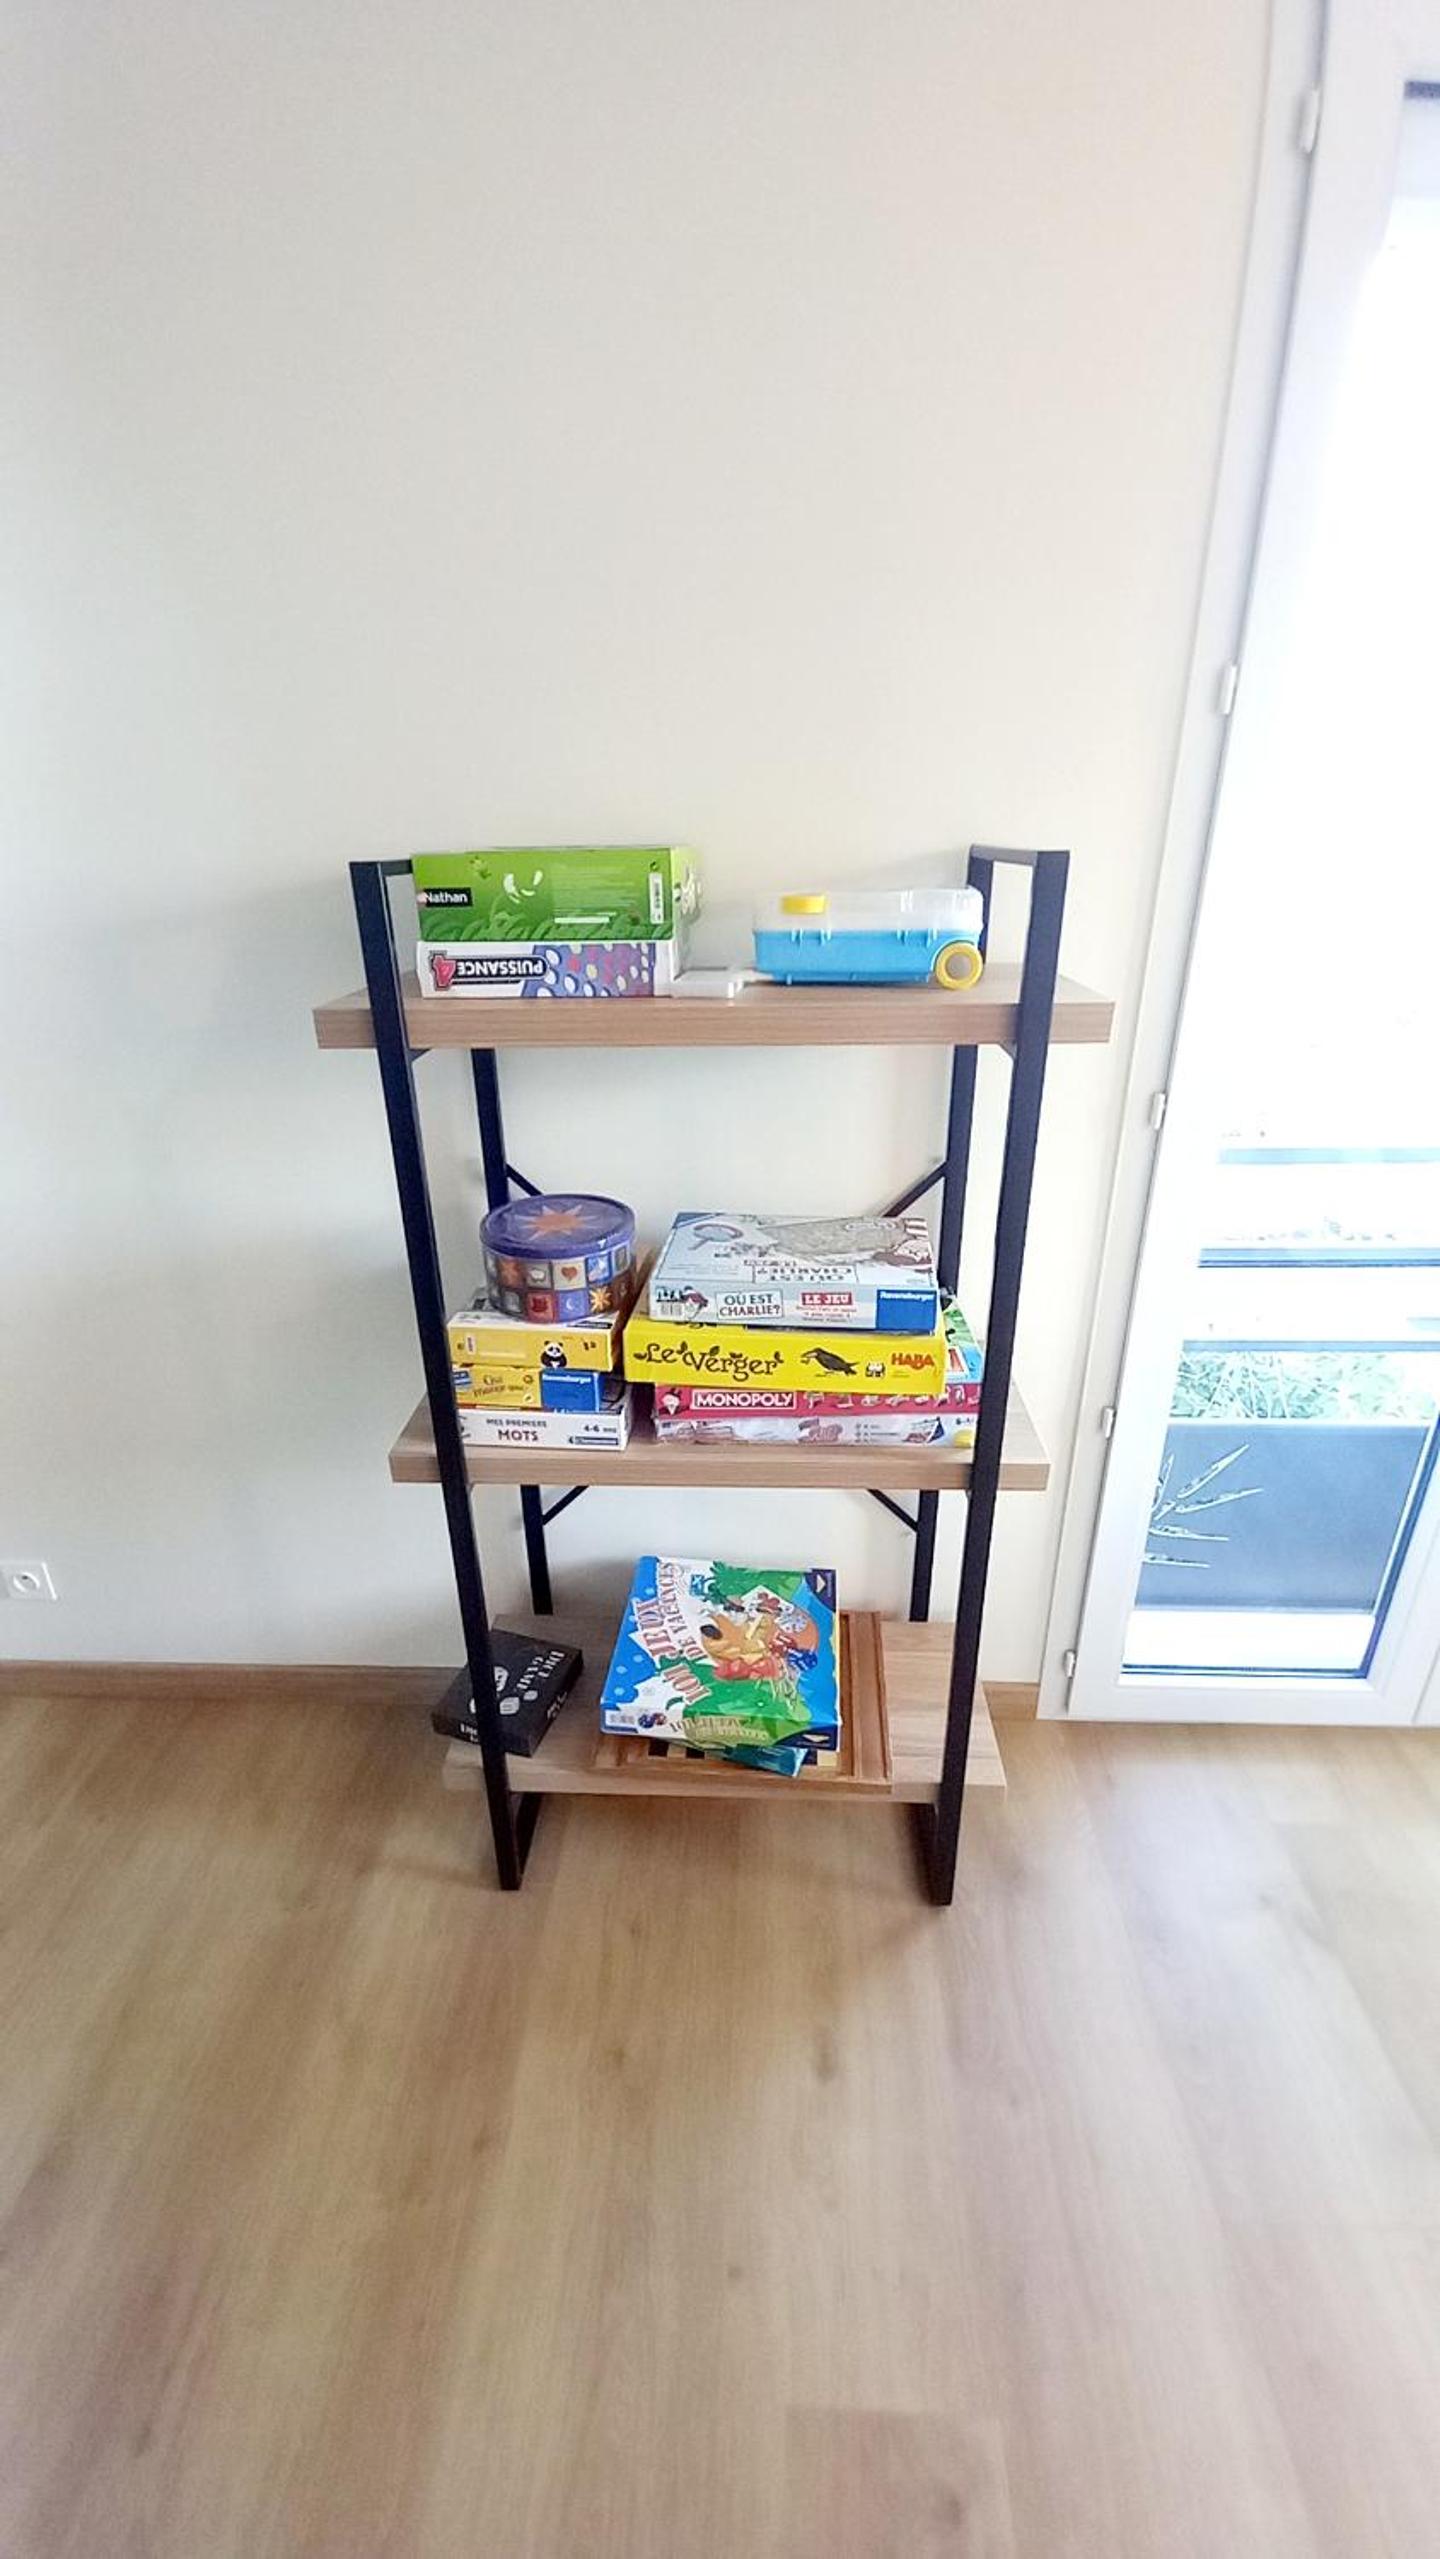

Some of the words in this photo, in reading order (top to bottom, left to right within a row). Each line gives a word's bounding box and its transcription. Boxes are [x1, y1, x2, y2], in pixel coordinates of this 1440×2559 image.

[426, 890, 469, 904] Nathan
[433, 954, 456, 989] 4
[457, 959, 544, 975] PUISSANCE
[747, 1293, 773, 1305] EST
[804, 1294, 822, 1304] LE
[824, 1294, 850, 1304] JEU
[719, 1304, 781, 1317] CHARLIE?
[642, 1342, 678, 1363] Le
[681, 1347, 781, 1382] Verger
[891, 1352, 935, 1370] HABA
[696, 1393, 793, 1407] MONOPOLY
[498, 1430, 540, 1442] MOTS
[583, 1424, 600, 1433] 4-6
[658, 1560, 687, 1634] VACANCES
[636, 1599, 678, 1660] JEUX
[677, 1636, 708, 1660] DE
